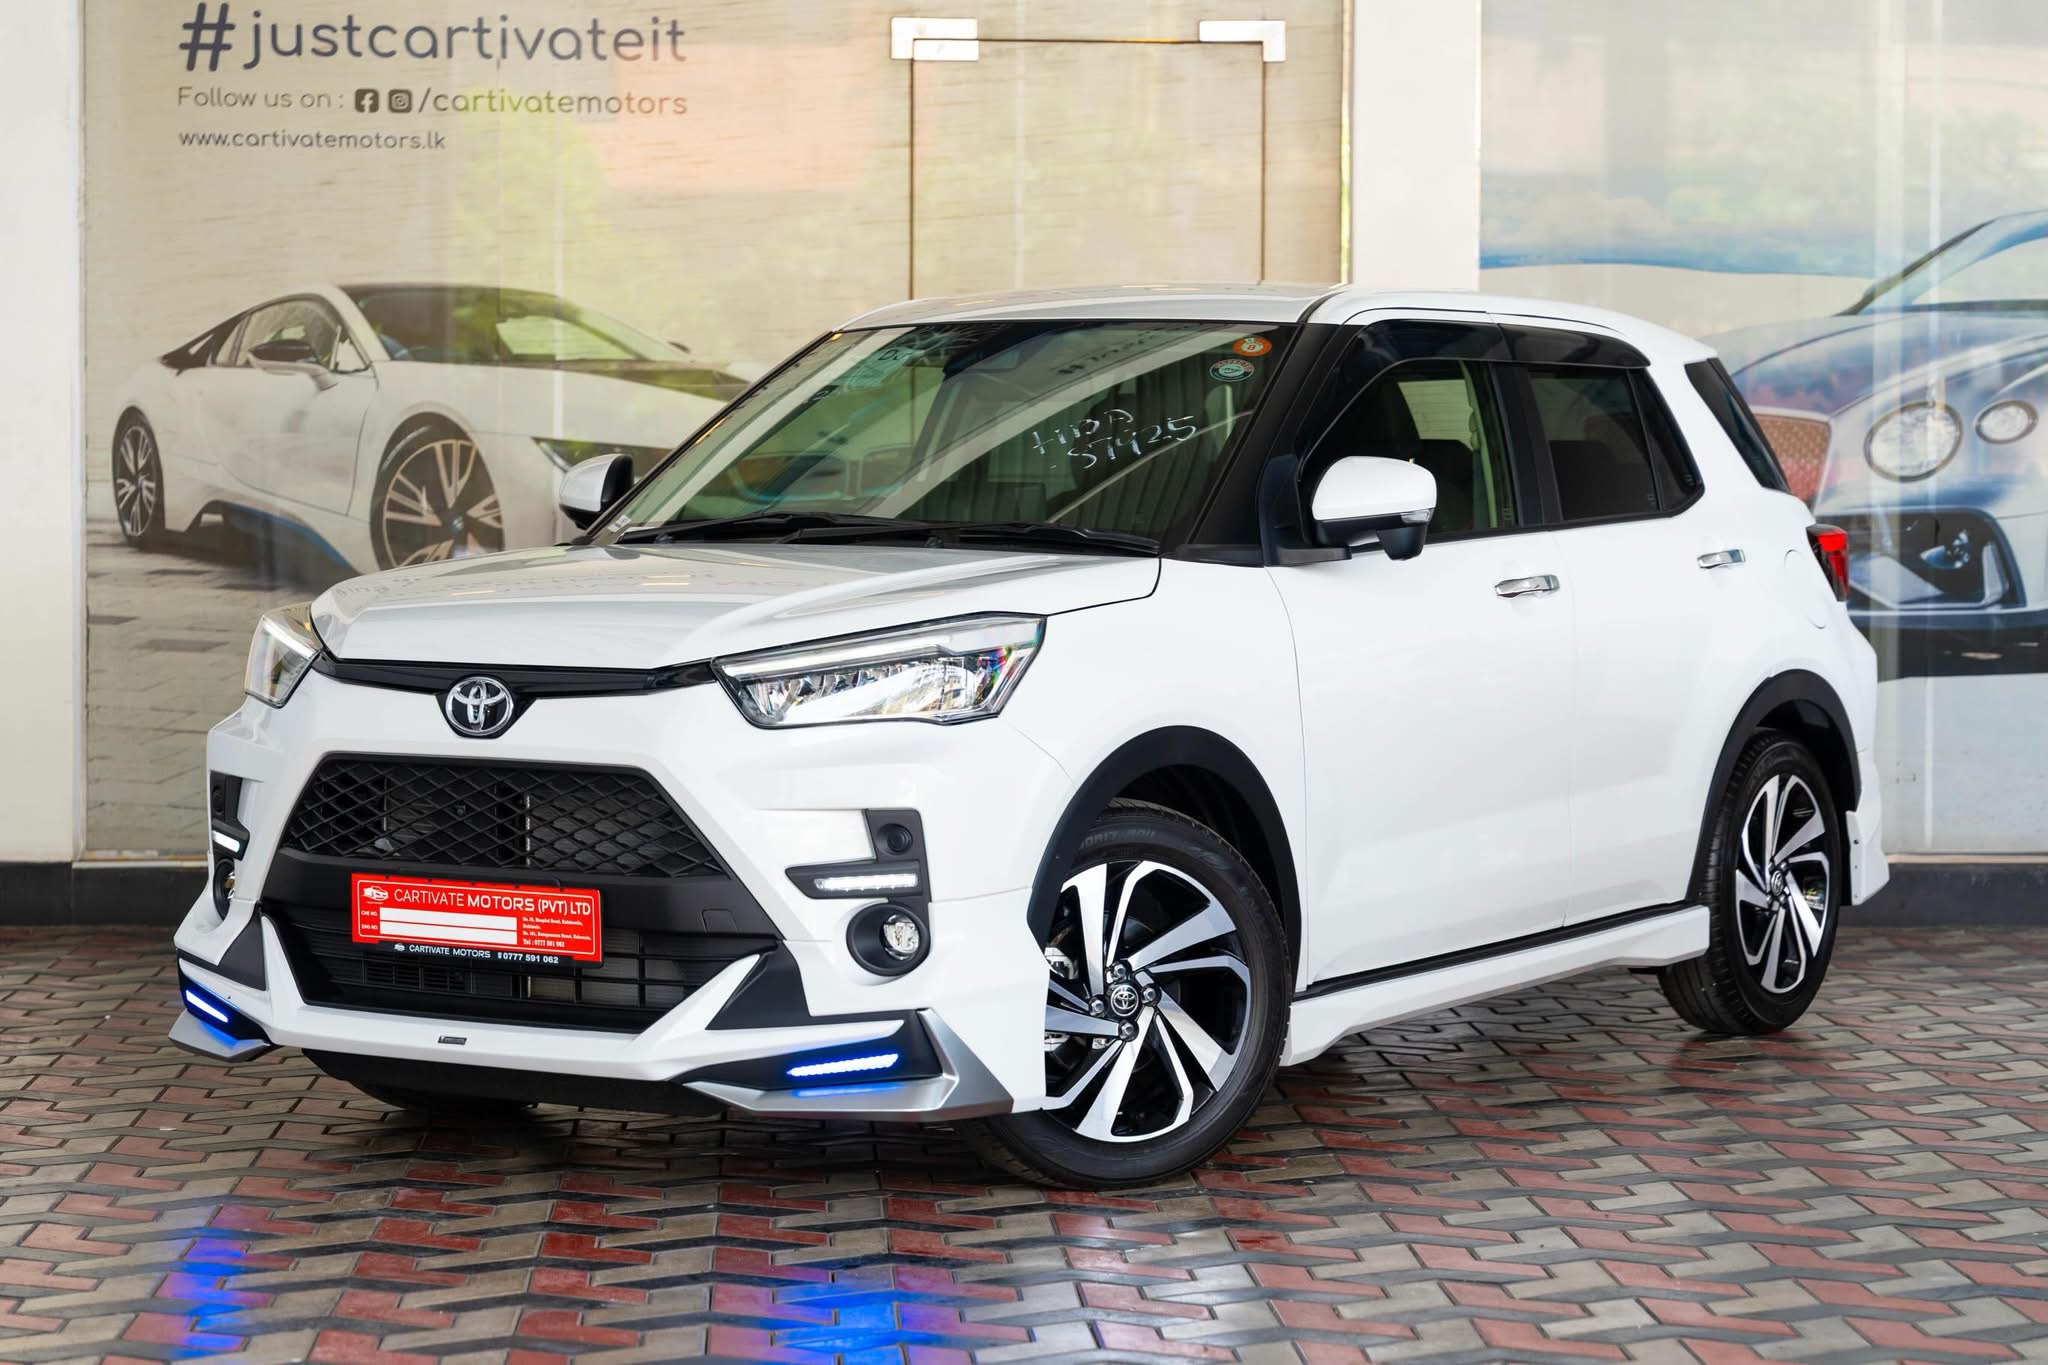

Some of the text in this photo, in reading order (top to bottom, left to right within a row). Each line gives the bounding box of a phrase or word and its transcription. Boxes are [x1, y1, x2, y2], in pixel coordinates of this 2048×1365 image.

[179, 3, 687, 71] #justcartivateit
[177, 86, 257, 107] Follow
[264, 92, 293, 108] us
[299, 92, 332, 108] on
[418, 87, 688, 115] /cartivatemotors
[178, 130, 446, 150] www.cartivatemotors.lk
[394, 888, 591, 916] CARTIVATE MOTORS (PVT) LTD
[409, 944, 559, 964] CARTIVATE MOTORS 0777 591 062
